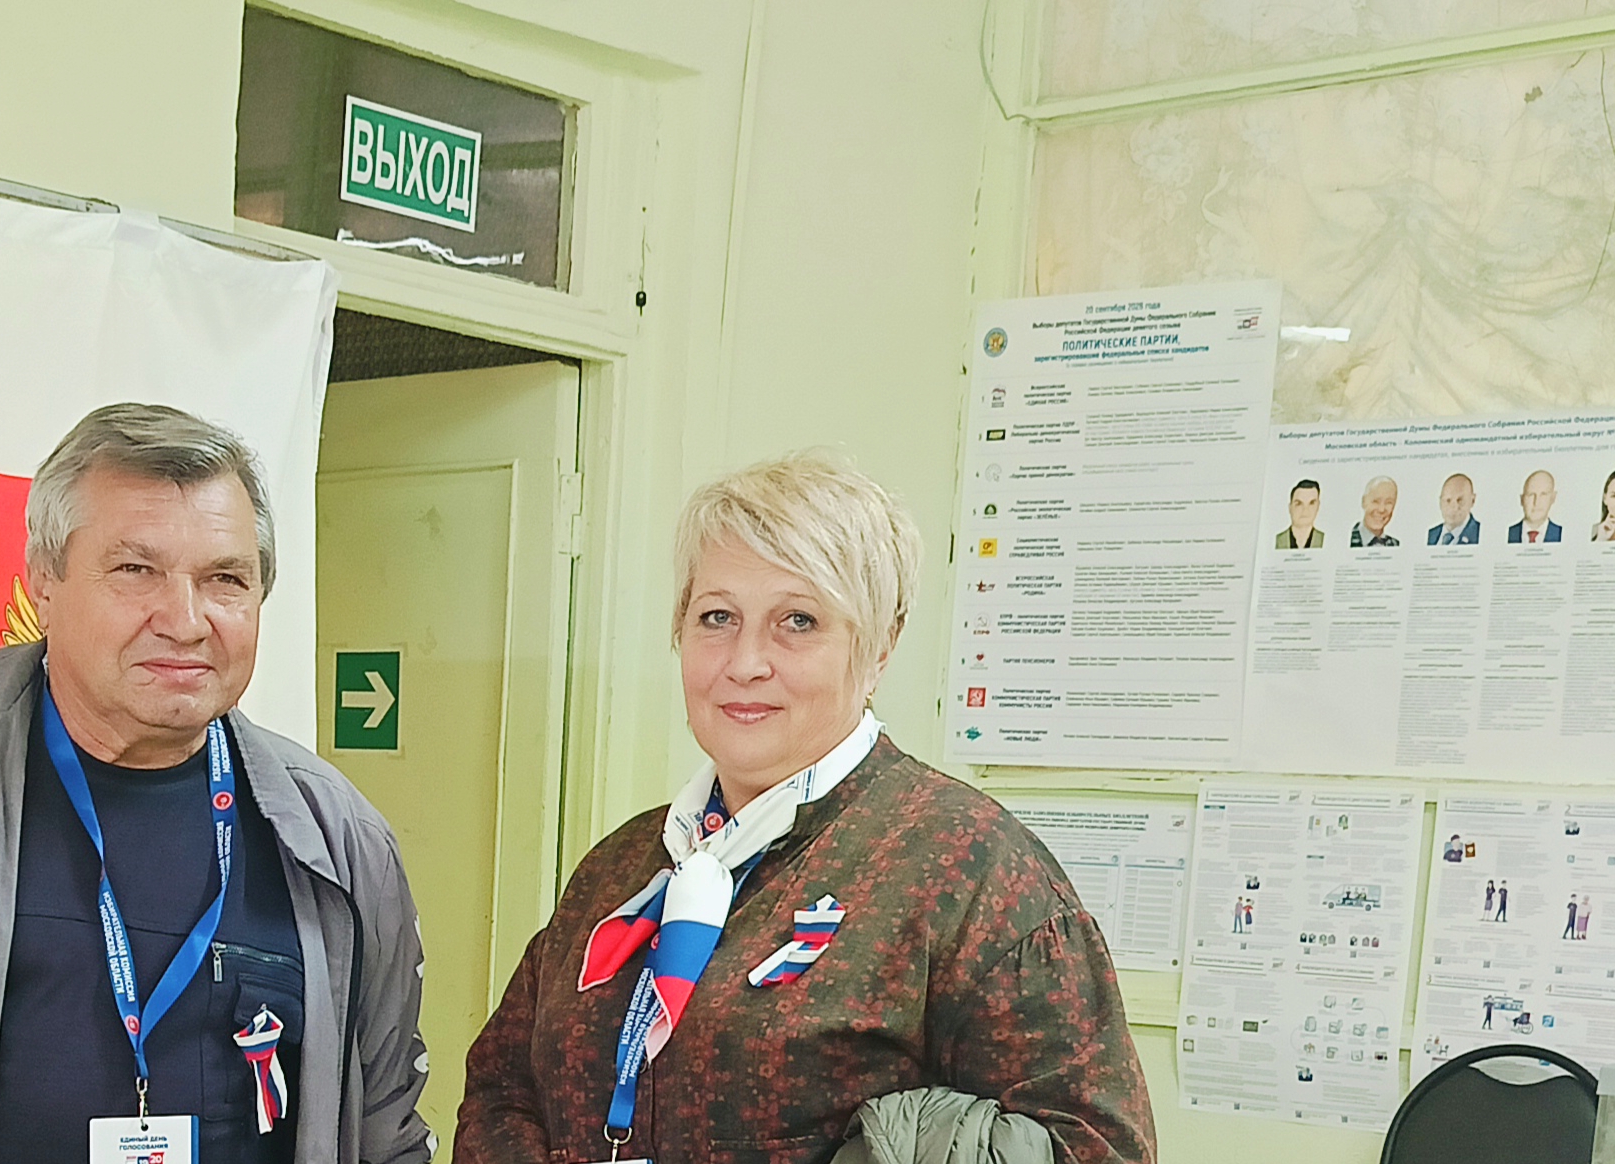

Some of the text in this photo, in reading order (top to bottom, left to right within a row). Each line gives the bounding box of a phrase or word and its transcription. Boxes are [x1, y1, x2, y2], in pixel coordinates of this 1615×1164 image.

[350, 117, 472, 218] ВЫХОД
[1062, 333, 1181, 352] ПОЛИТИЧЕСКИЕ ПАРТИИ,
[1279, 432, 1308, 440] Выборы
[1309, 430, 1345, 439] депутатов
[1346, 426, 1408, 437] Государственной
[1409, 424, 1431, 434] Думы
[1432, 421, 1486, 432] Федерального
[1487, 419, 1526, 429] Собрания
[1527, 416, 1572, 426] Российской
[1325, 442, 1367, 450] Московская
[1368, 440, 1397, 448] область
[1519, 430, 1581, 441] избирательный
[1582, 430, 1604, 439] округ
[99, 904, 125, 994] МОСКОВСКОЙ ОБЛАСТИ
[103, 891, 136, 1003] ИЗБИРАТЕЛЬНАЯ КОМИССИЯ
[619, 1023, 647, 1085] ИЗБИРАТЕЛЬНАЯ
[119, 1143, 169, 1151] ГОЛОСОВАНИЯ
[120, 1135, 149, 1144] ЕДИНЫЙ
[149, 1154, 163, 1164] 20
